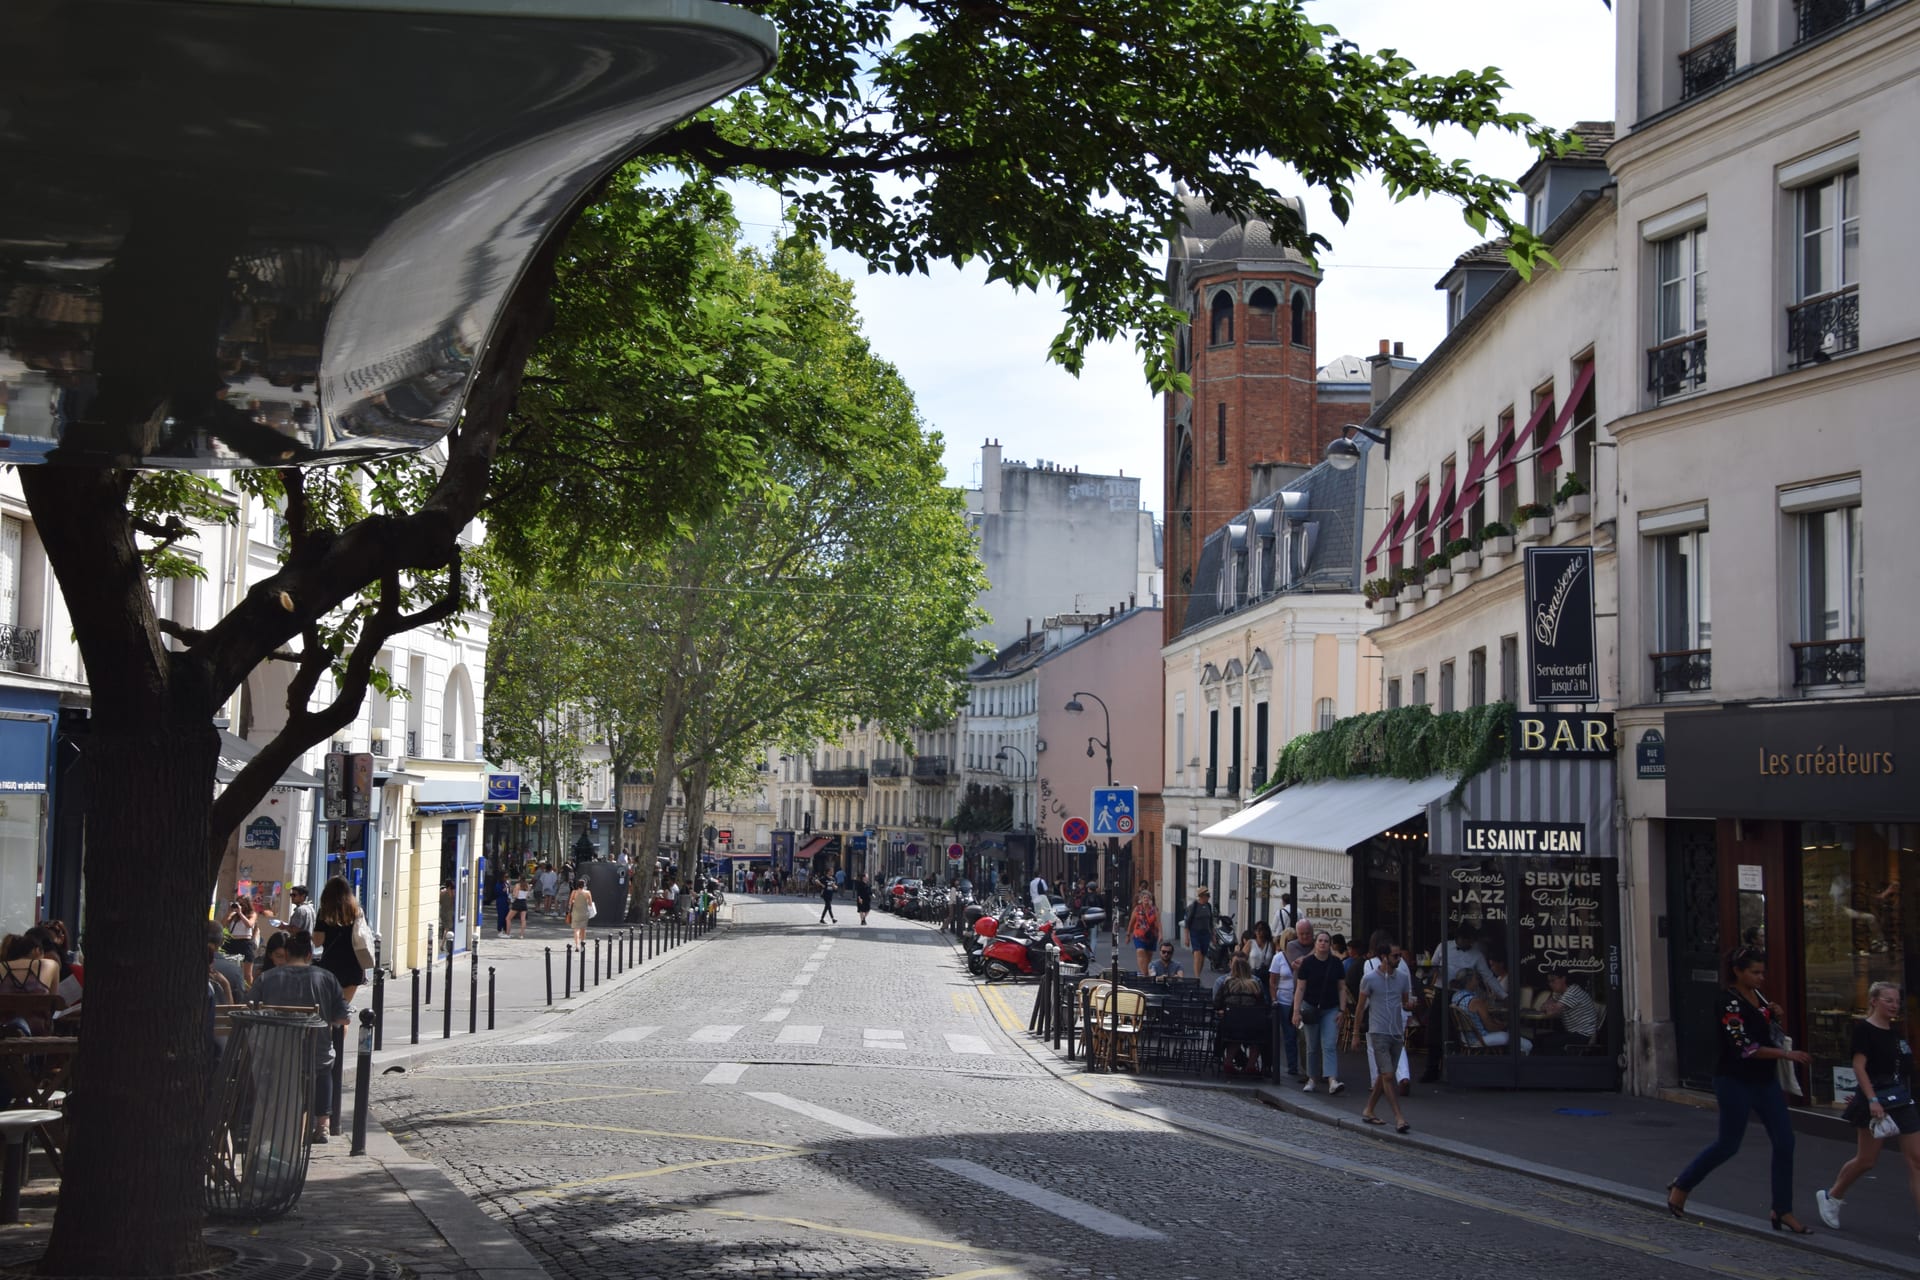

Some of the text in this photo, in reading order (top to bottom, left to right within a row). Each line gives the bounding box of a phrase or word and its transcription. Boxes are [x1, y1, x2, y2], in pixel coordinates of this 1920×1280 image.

[1535, 555, 1583, 646] Brasserie
[1536, 663, 1586, 677] Service tardif
[1518, 719, 1610, 752] BAR
[1647, 749, 1657, 757] RUE
[1759, 744, 1894, 775] Les créateurs
[1640, 765, 1665, 773] ABBESSES
[489, 779, 515, 789] LCL
[1120, 820, 1130, 828] 20
[1467, 828, 1582, 851] LE SAINT JEAN
[1451, 866, 1505, 887] Concert
[1525, 871, 1601, 886] SERVICE
[1451, 889, 1505, 904] JAZZ
[1531, 888, 1599, 911] Continu
[1519, 914, 1536, 928] de
[1538, 912, 1557, 927] 7h
[1570, 913, 1582, 927] 1h
[1533, 934, 1594, 949] DINER
